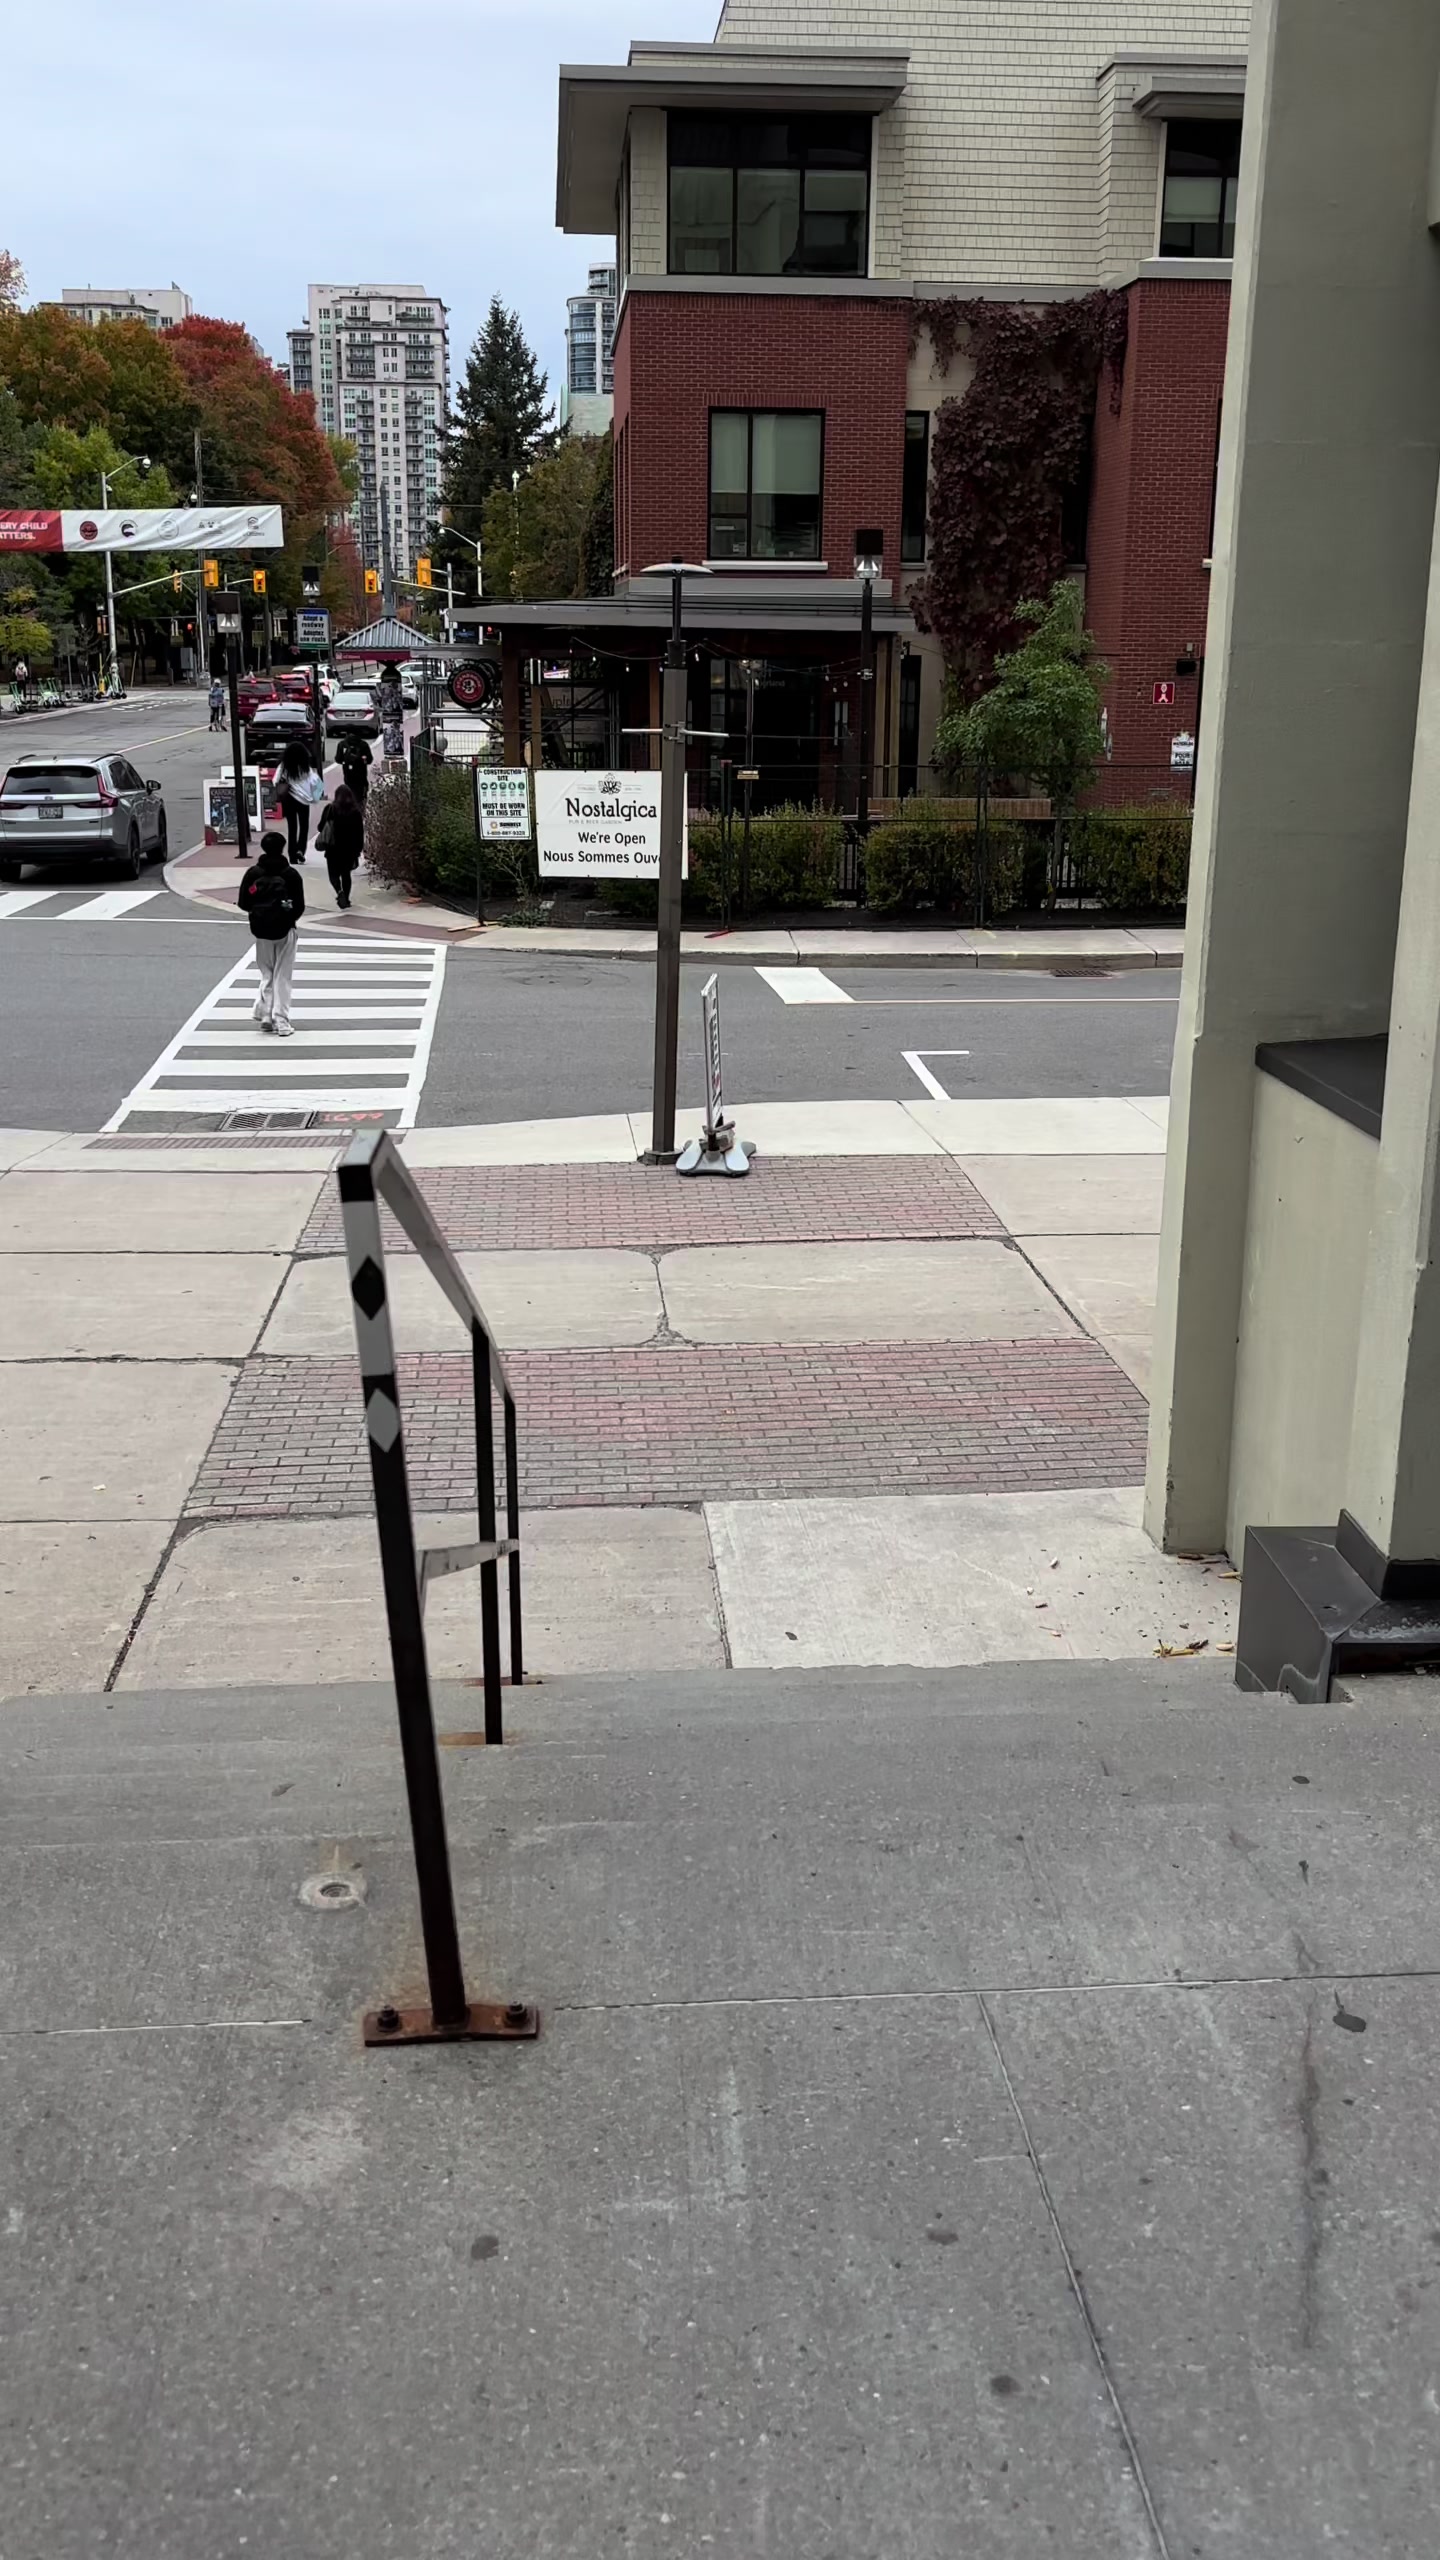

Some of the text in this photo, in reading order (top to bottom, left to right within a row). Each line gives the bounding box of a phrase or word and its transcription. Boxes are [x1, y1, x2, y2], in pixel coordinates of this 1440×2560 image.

[20, 522, 48, 530] CHILD
[565, 797, 658, 822] Nostalgica
[577, 831, 646, 847] We're Open
[543, 850, 660, 864] Nous Sommes Ouv
